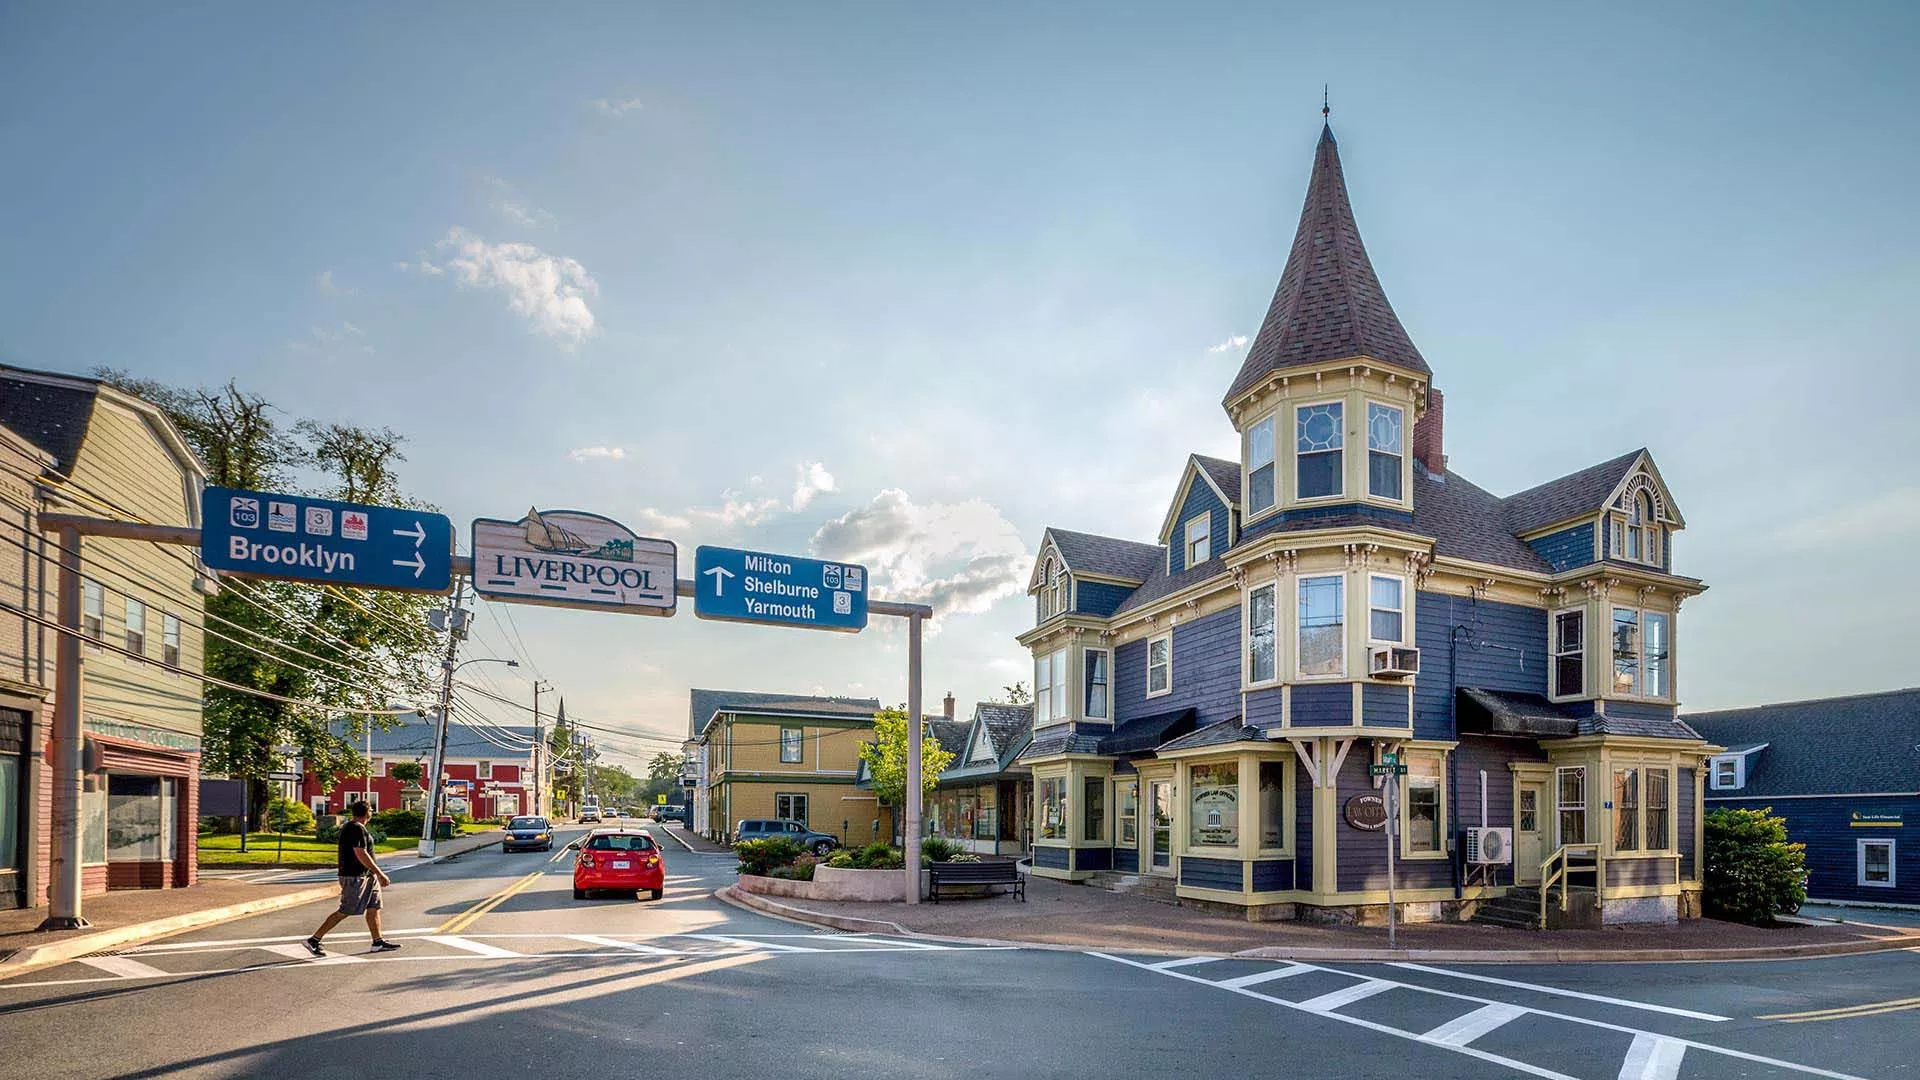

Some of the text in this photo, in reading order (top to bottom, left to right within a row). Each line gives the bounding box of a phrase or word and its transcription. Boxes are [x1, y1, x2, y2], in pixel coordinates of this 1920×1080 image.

[234, 512, 256, 522] 103
[314, 513, 324, 525] 3
[230, 535, 355, 574] Brooklyn
[495, 554, 657, 591] LIVERPOOL
[744, 555, 791, 575] Milton
[744, 576, 819, 599] Shelburne
[826, 575, 839, 584] 103
[744, 598, 816, 620] Yarmouth
[839, 596, 846, 605] 3
